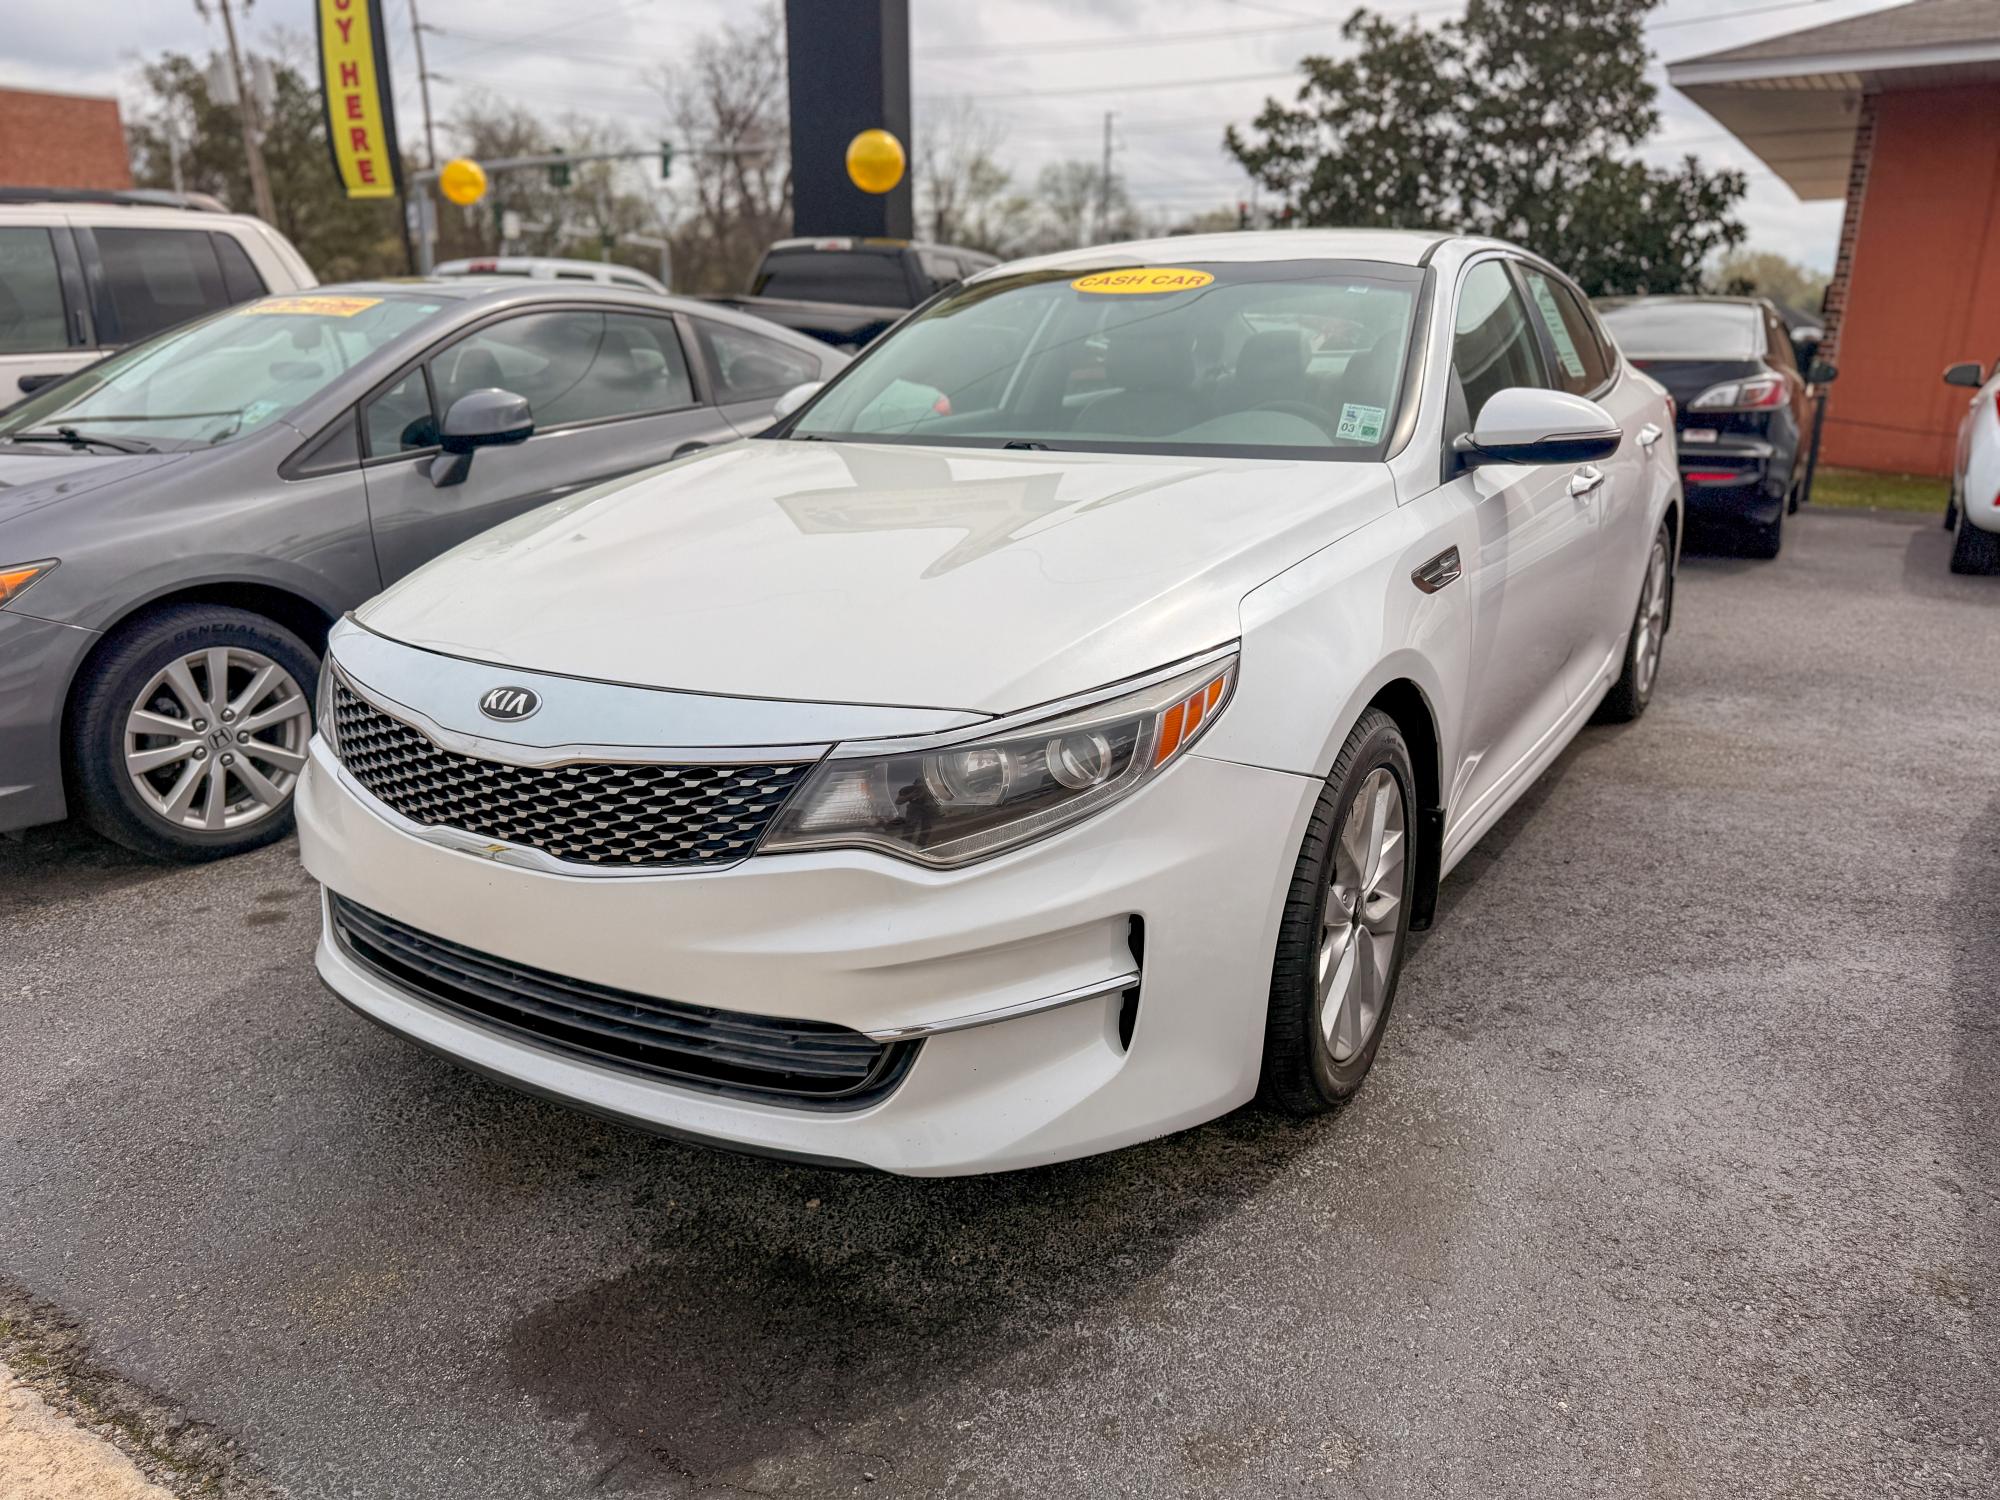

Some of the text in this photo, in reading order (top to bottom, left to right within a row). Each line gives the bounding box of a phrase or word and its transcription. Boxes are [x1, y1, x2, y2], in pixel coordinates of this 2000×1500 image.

[340, 61, 376, 185] HERE
[1079, 275, 1206, 287] CASH CAR
[1341, 423, 1355, 433] 03
[174, 623, 258, 644] GENERAL
[483, 689, 529, 715] KIA
